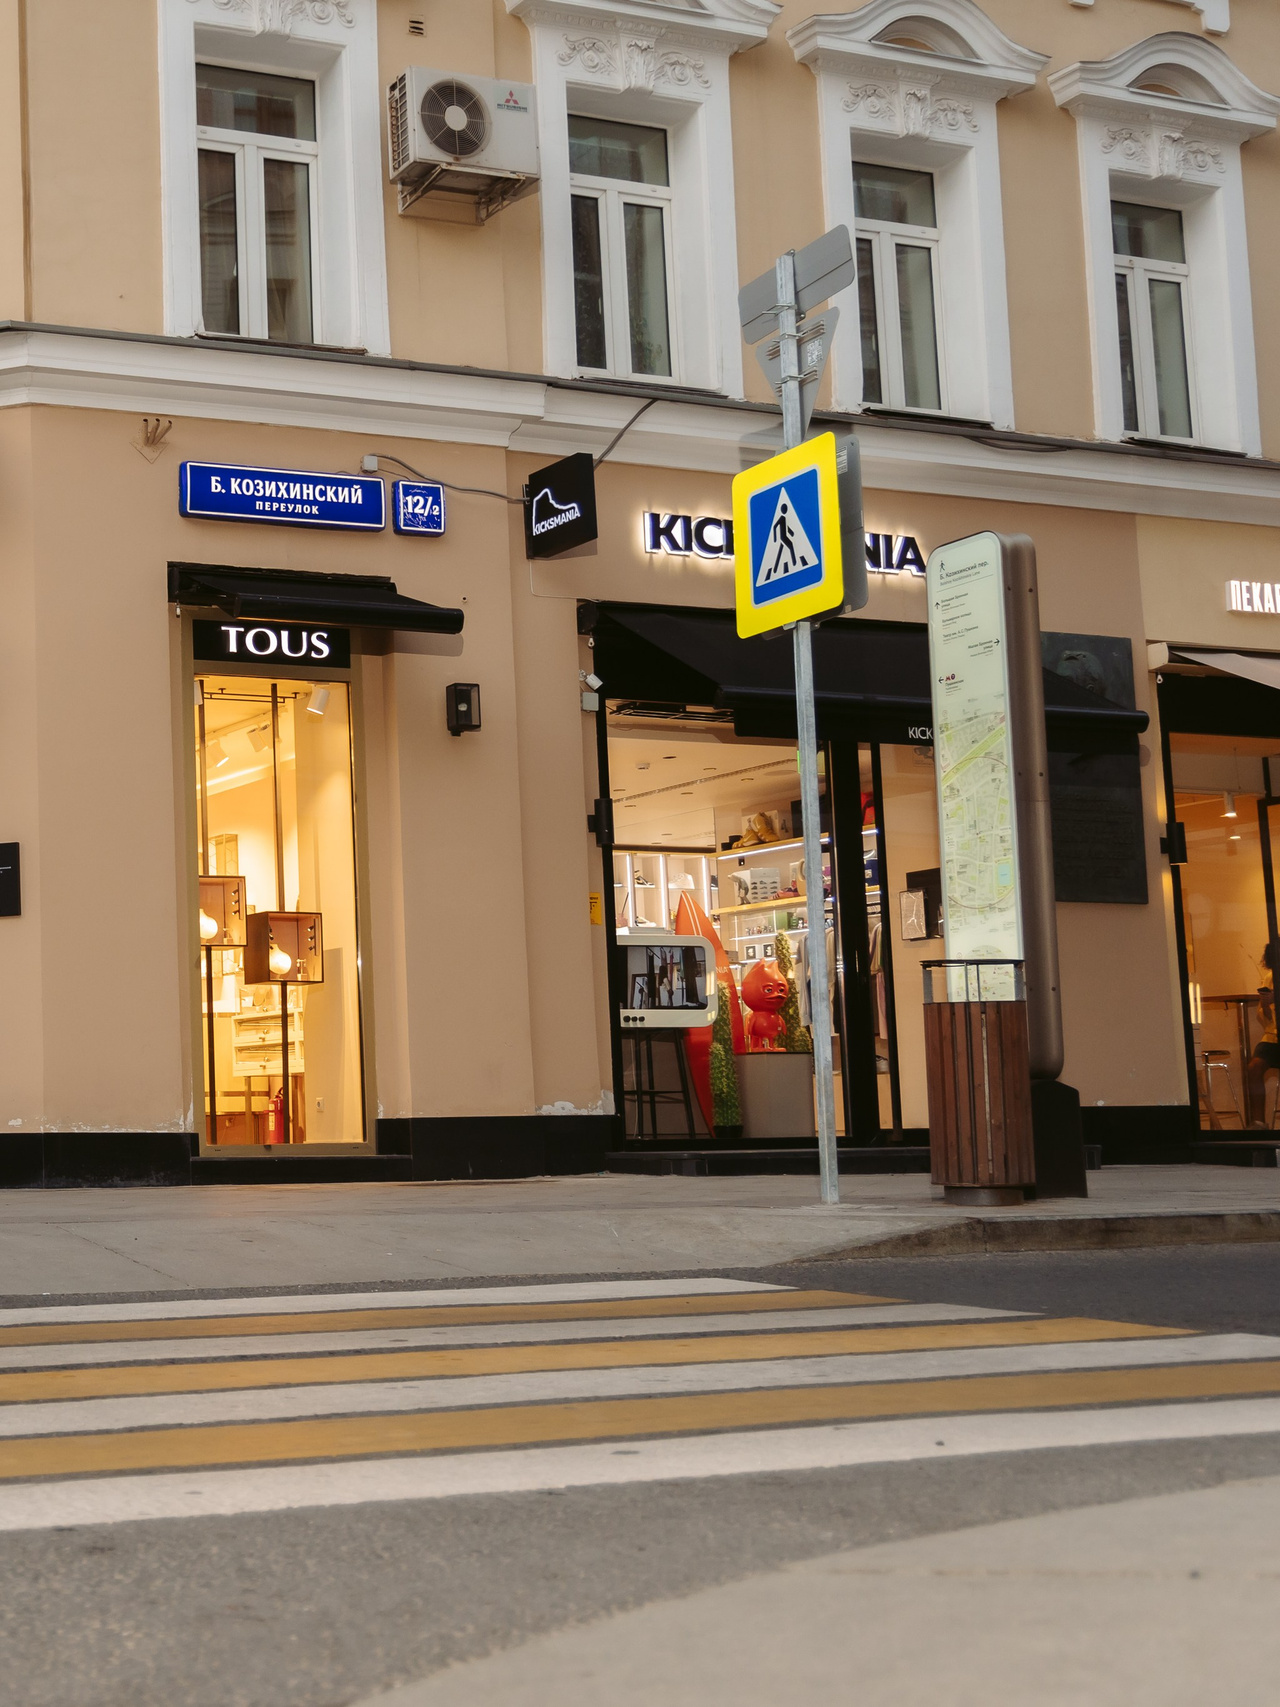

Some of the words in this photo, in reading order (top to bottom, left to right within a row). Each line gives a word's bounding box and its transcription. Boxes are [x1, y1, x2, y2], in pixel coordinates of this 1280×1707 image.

[210, 476, 227, 494] Б.
[231, 477, 363, 505] КОЗИХИНСКИЙ
[255, 501, 320, 515] ПЕРЕУЛОК
[533, 508, 581, 536] KICKSMANIA
[221, 626, 330, 659] TOUS
